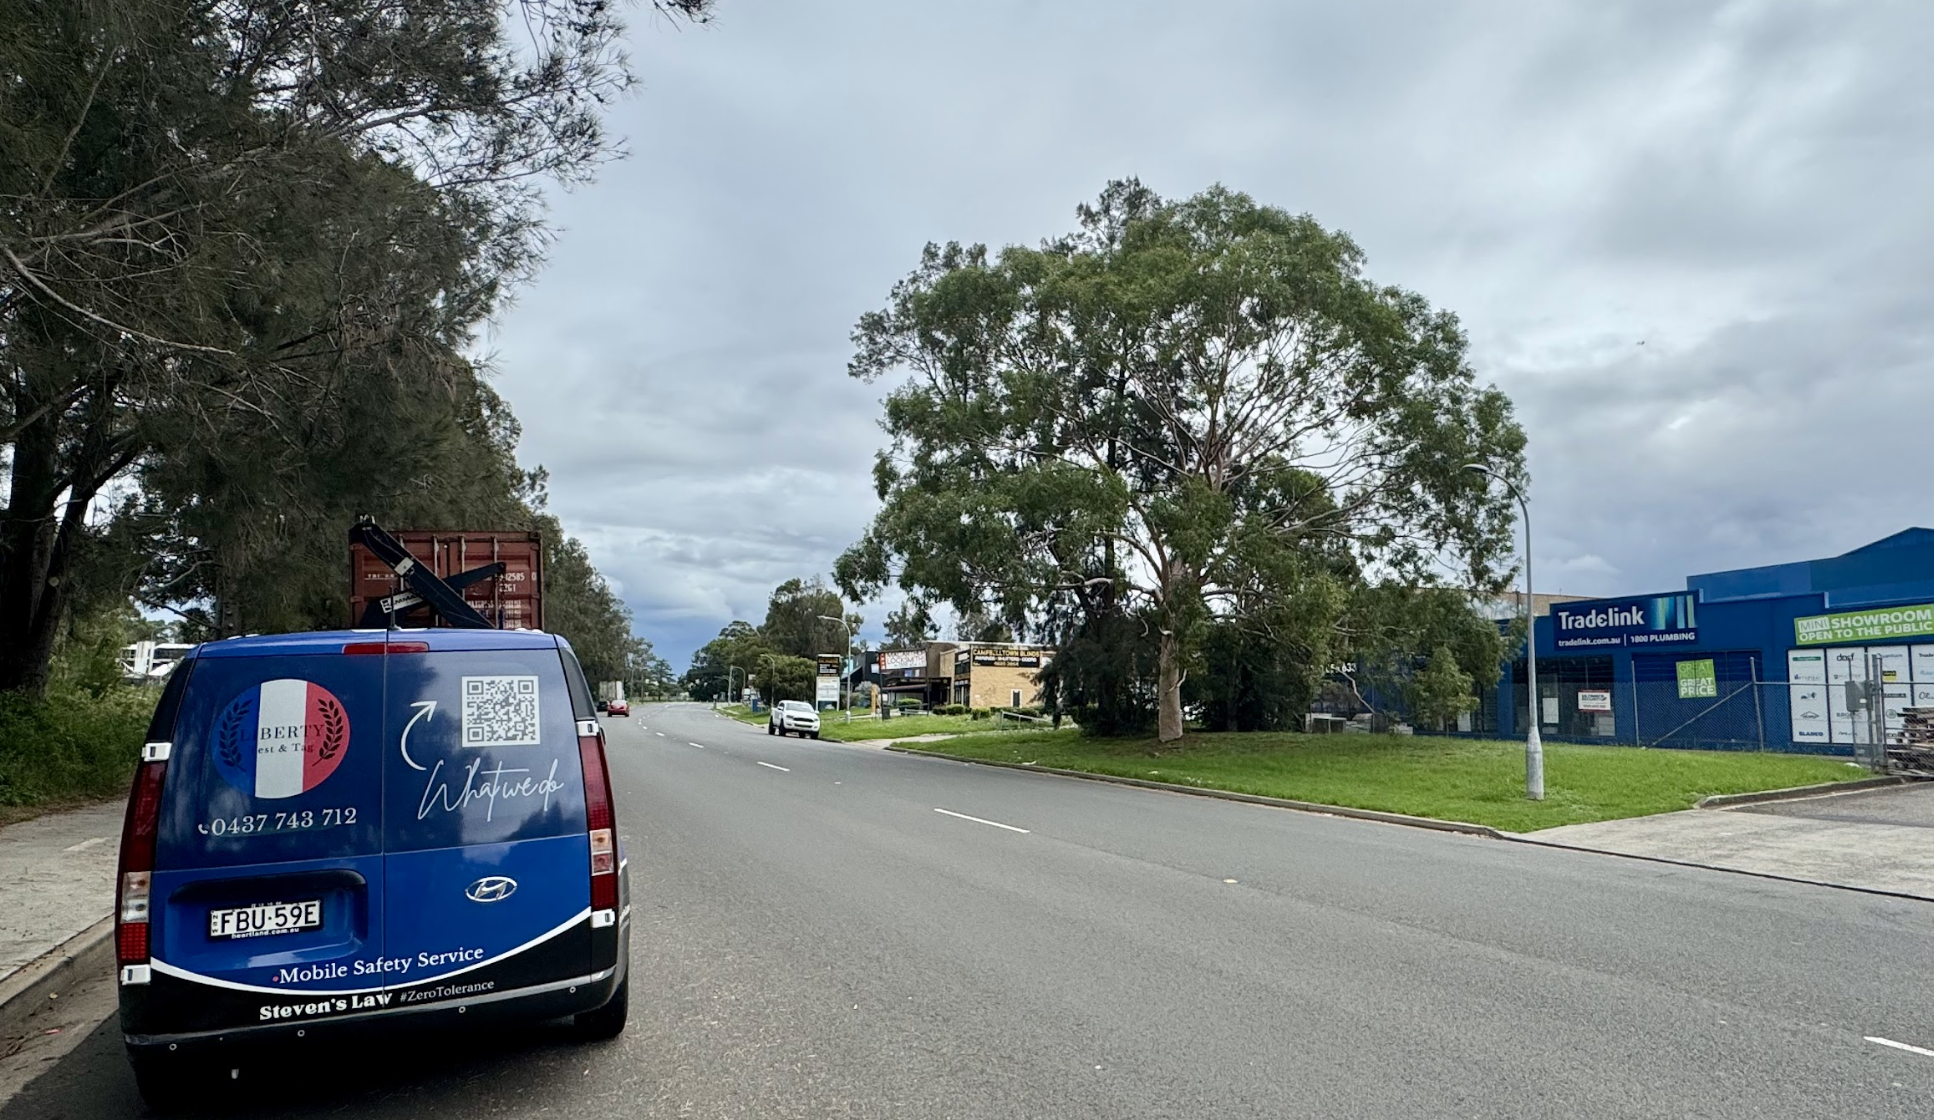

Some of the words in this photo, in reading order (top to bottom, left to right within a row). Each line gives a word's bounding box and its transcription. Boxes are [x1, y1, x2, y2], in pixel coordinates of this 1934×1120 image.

[1558, 606, 1645, 630] Tradelink
[1800, 618, 1829, 632] MINI
[1831, 609, 1933, 629] SHOWROOM
[1630, 635, 1648, 643] 1800
[1650, 632, 1696, 642] PLUMBING
[1799, 631, 1833, 642] OPEN
[1836, 628, 1853, 638] TO
[1856, 626, 1882, 636] THE
[1885, 621, 1934, 634] PUBLIC
[1558, 637, 1621, 647] tradelink.com.au
[1681, 686, 1715, 696] PRICE
[240, 724, 324, 741] LBERTY
[278, 744, 287, 753] &
[291, 742, 315, 753] Tag
[211, 814, 268, 836] 0437
[275, 810, 314, 830] 743
[322, 807, 357, 826] 712
[231, 927, 300, 939] heartland.com.au
[279, 962, 348, 984] Mobile
[353, 954, 412, 975] Safety
[417, 947, 485, 968] Service
[259, 997, 347, 1021] Steven's
[352, 992, 393, 1010] Law
[400, 979, 495, 1002] #ZeroTolerance
